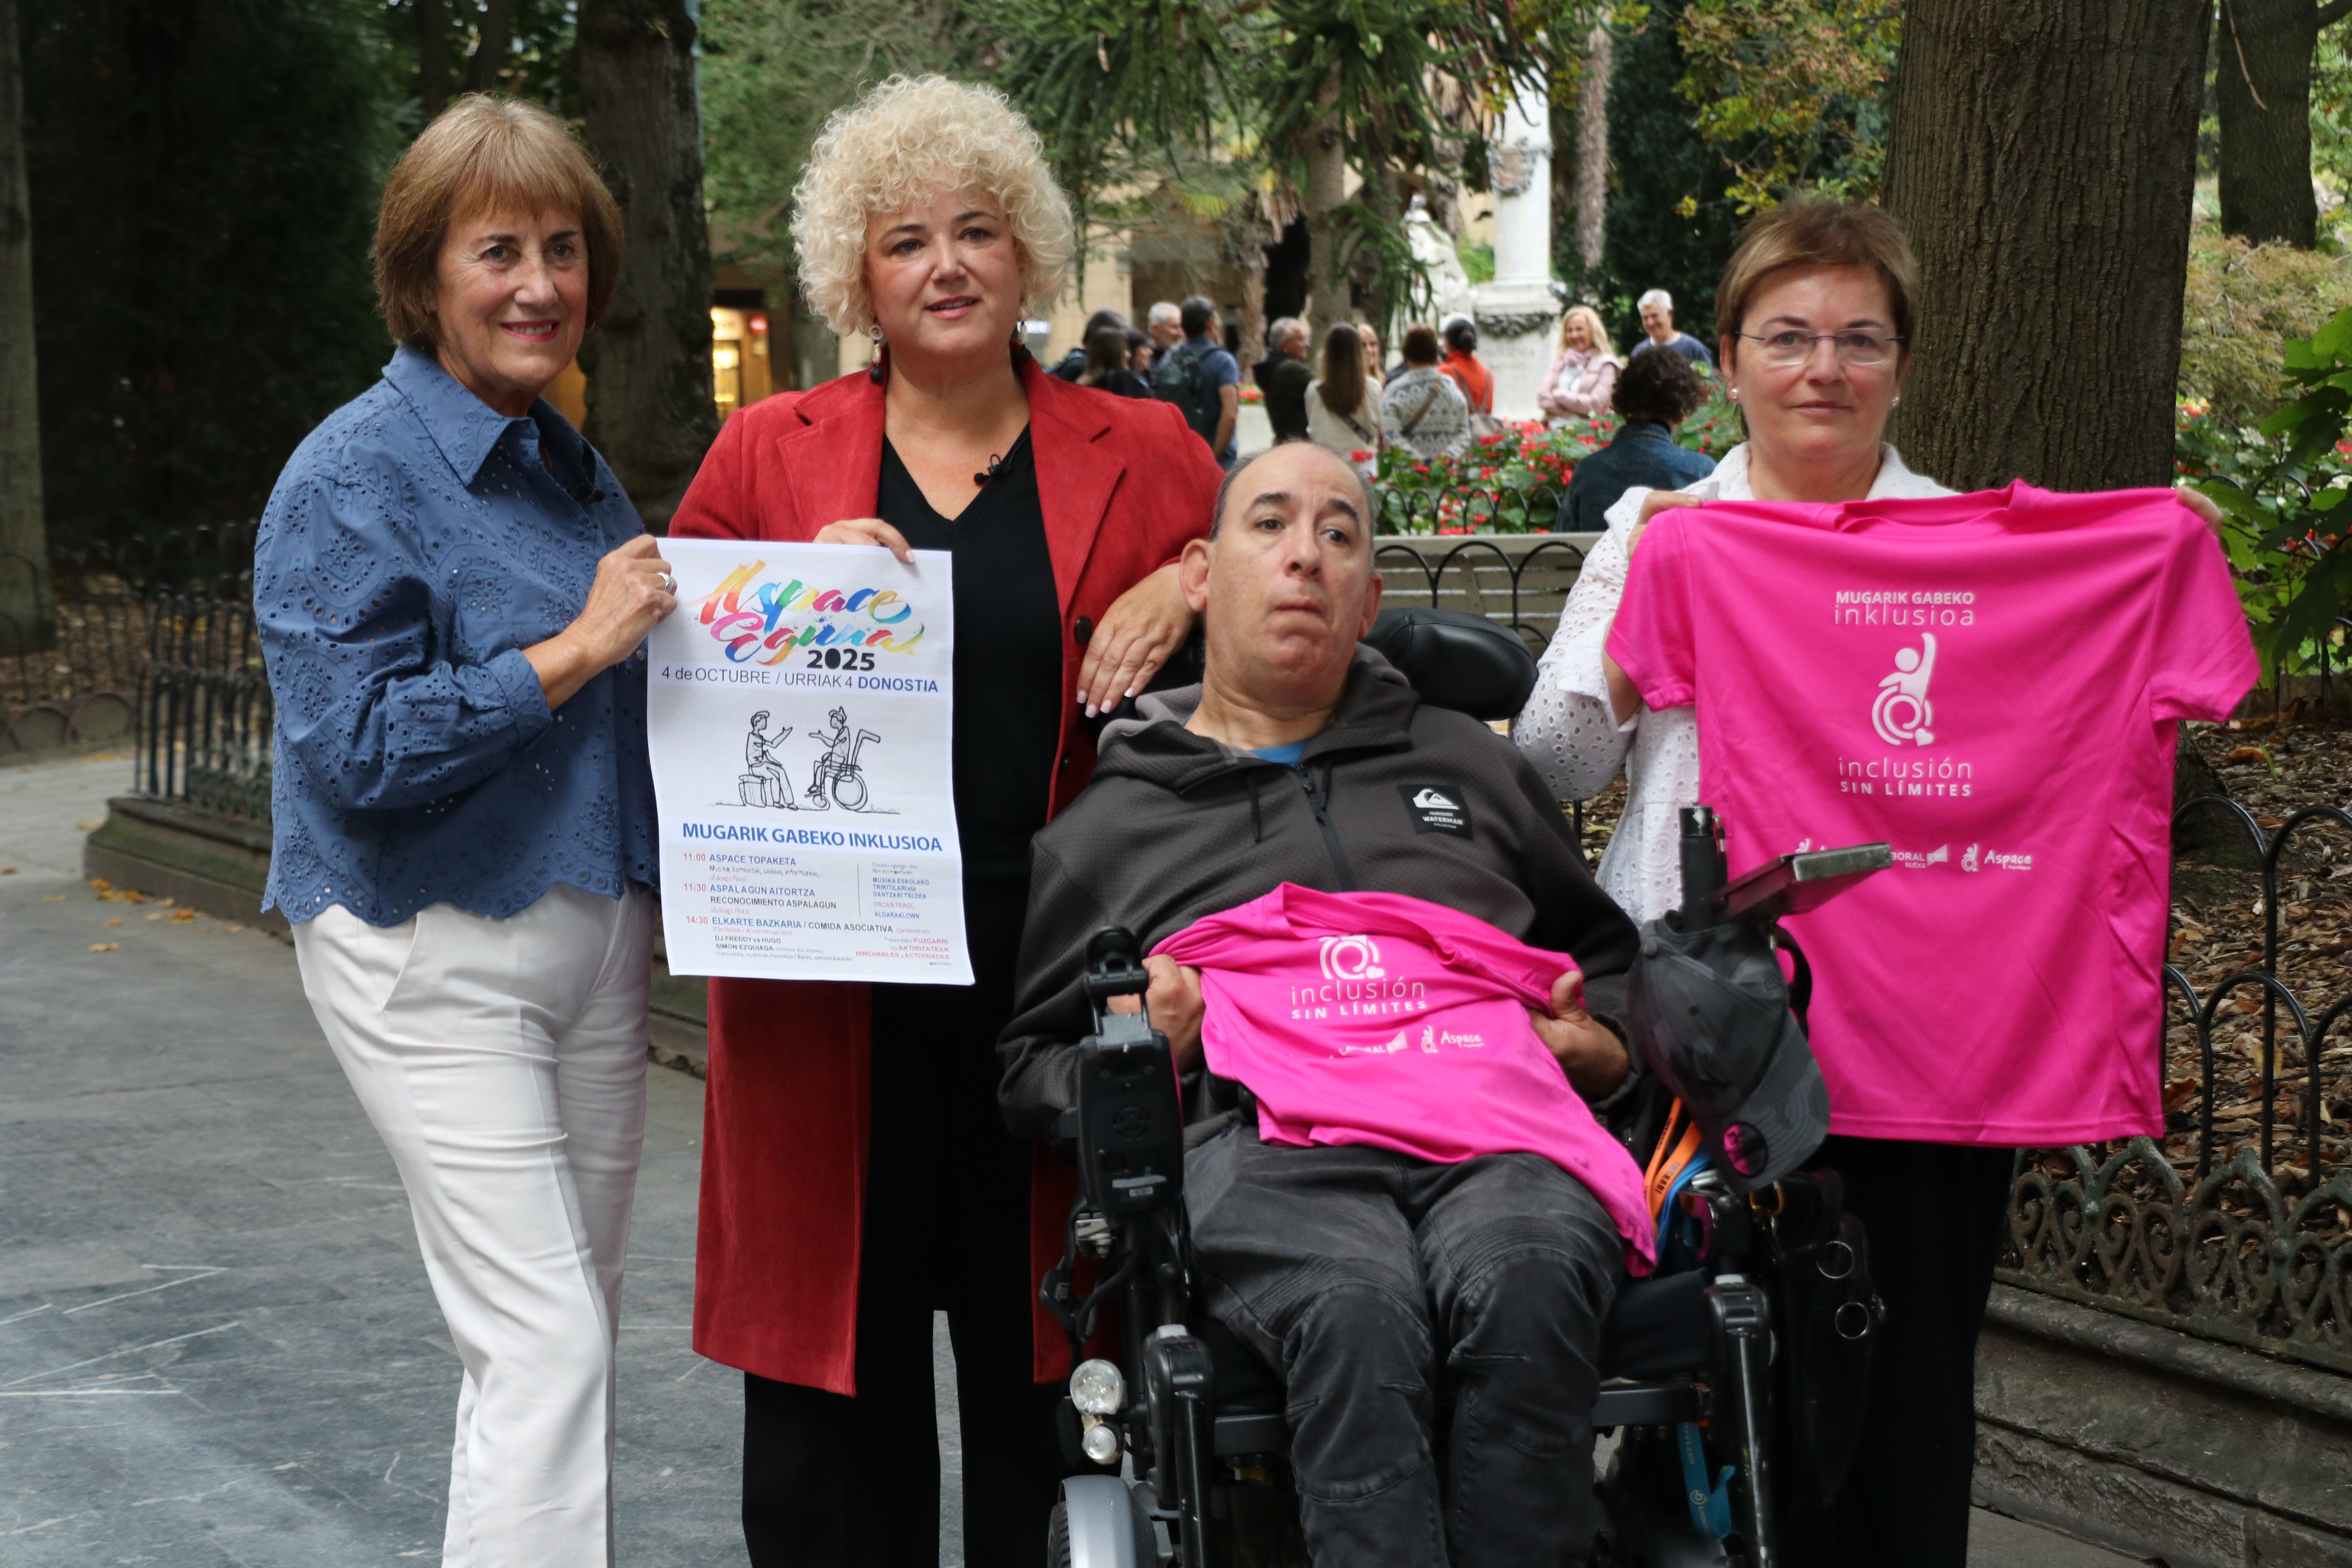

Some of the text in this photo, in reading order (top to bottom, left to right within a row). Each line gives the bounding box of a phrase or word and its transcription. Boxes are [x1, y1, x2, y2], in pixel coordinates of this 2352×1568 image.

[682, 559, 911, 633] Aspace
[1836, 591, 1975, 605] MUGARIK GABEKO
[1835, 604, 1975, 626] inklusioa
[806, 648, 875, 671] 2025
[662, 666, 938, 693] 4 de OCTUBRE / URRIAK 4 DONOSTIA
[1839, 757, 1971, 779] inclusión
[1840, 780, 1971, 797] SIN LÍMITES
[1422, 816, 1464, 826] WATERMAN
[682, 823, 943, 851] MUGARIK GABEKO INKLUSIOA
[683, 853, 797, 866] 11:00 ASPACE TOPAKETA
[1891, 851, 1926, 861] BORAL
[1984, 849, 2031, 870] Aspace
[684, 883, 815, 897] 11:30 ASPALAGUN AITORTZA
[710, 896, 837, 909] RECONOCIMIENTO ASPALAGUN
[686, 916, 708, 924] 14:30
[712, 917, 754, 926] ELKARTE
[756, 919, 802, 929] BAZKARIA
[808, 922, 842, 931] COMIDA
[844, 924, 893, 933] ASOCIATIVA
[1291, 976, 1425, 1005] inclusión
[1292, 1000, 1427, 1019] SIN LÍMITES
[1441, 1031, 1482, 1048] Aspace
